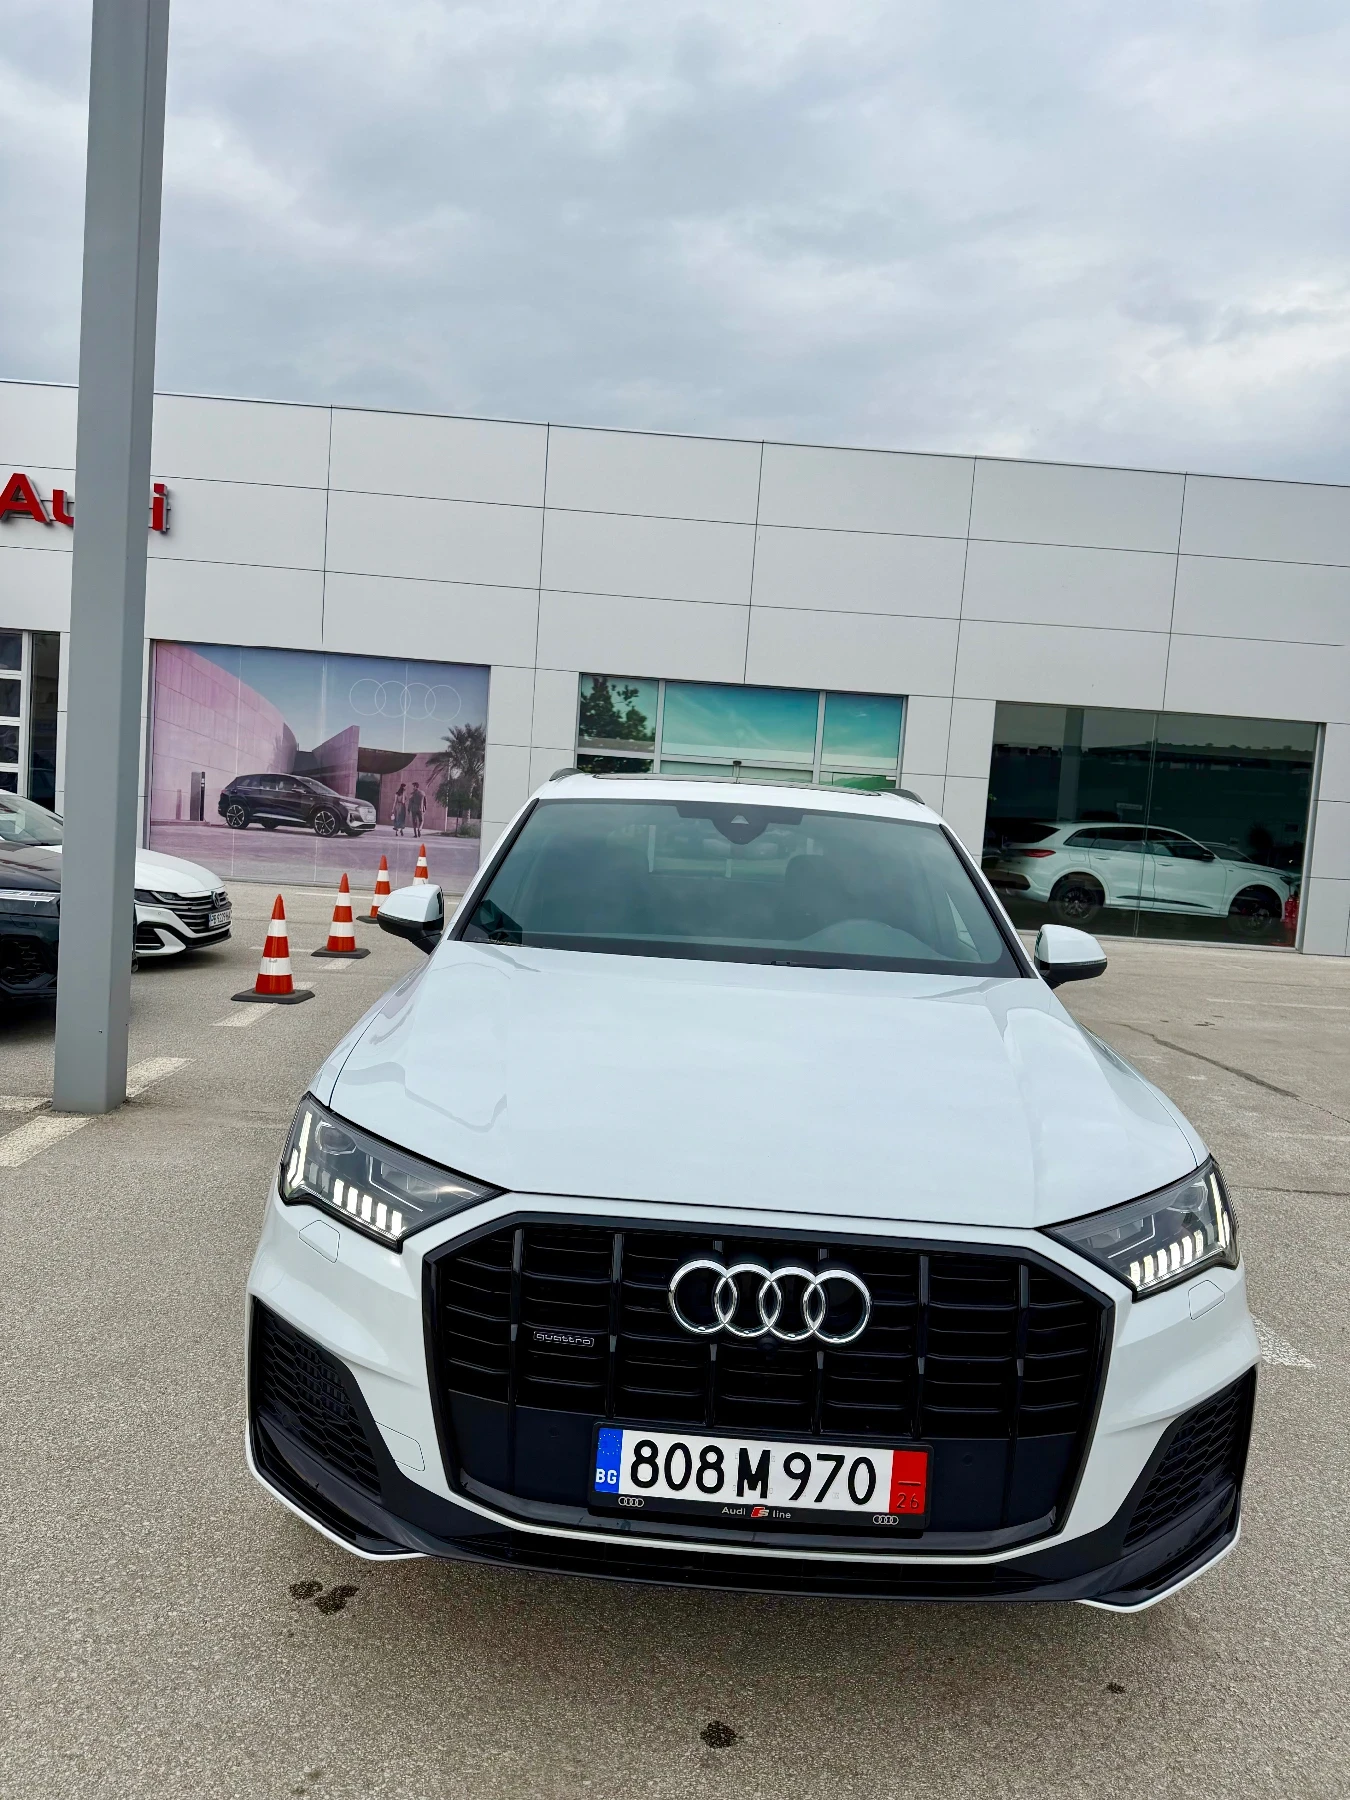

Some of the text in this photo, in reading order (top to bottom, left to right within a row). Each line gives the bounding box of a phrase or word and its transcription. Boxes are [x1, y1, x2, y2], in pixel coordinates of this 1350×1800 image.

[535, 1332, 592, 1346] quattro
[595, 1468, 618, 1485] BG
[630, 1439, 877, 1506] 808 M 970
[896, 1492, 919, 1509] 26
[721, 1506, 746, 1516] Audi
[772, 1509, 792, 1519] line
